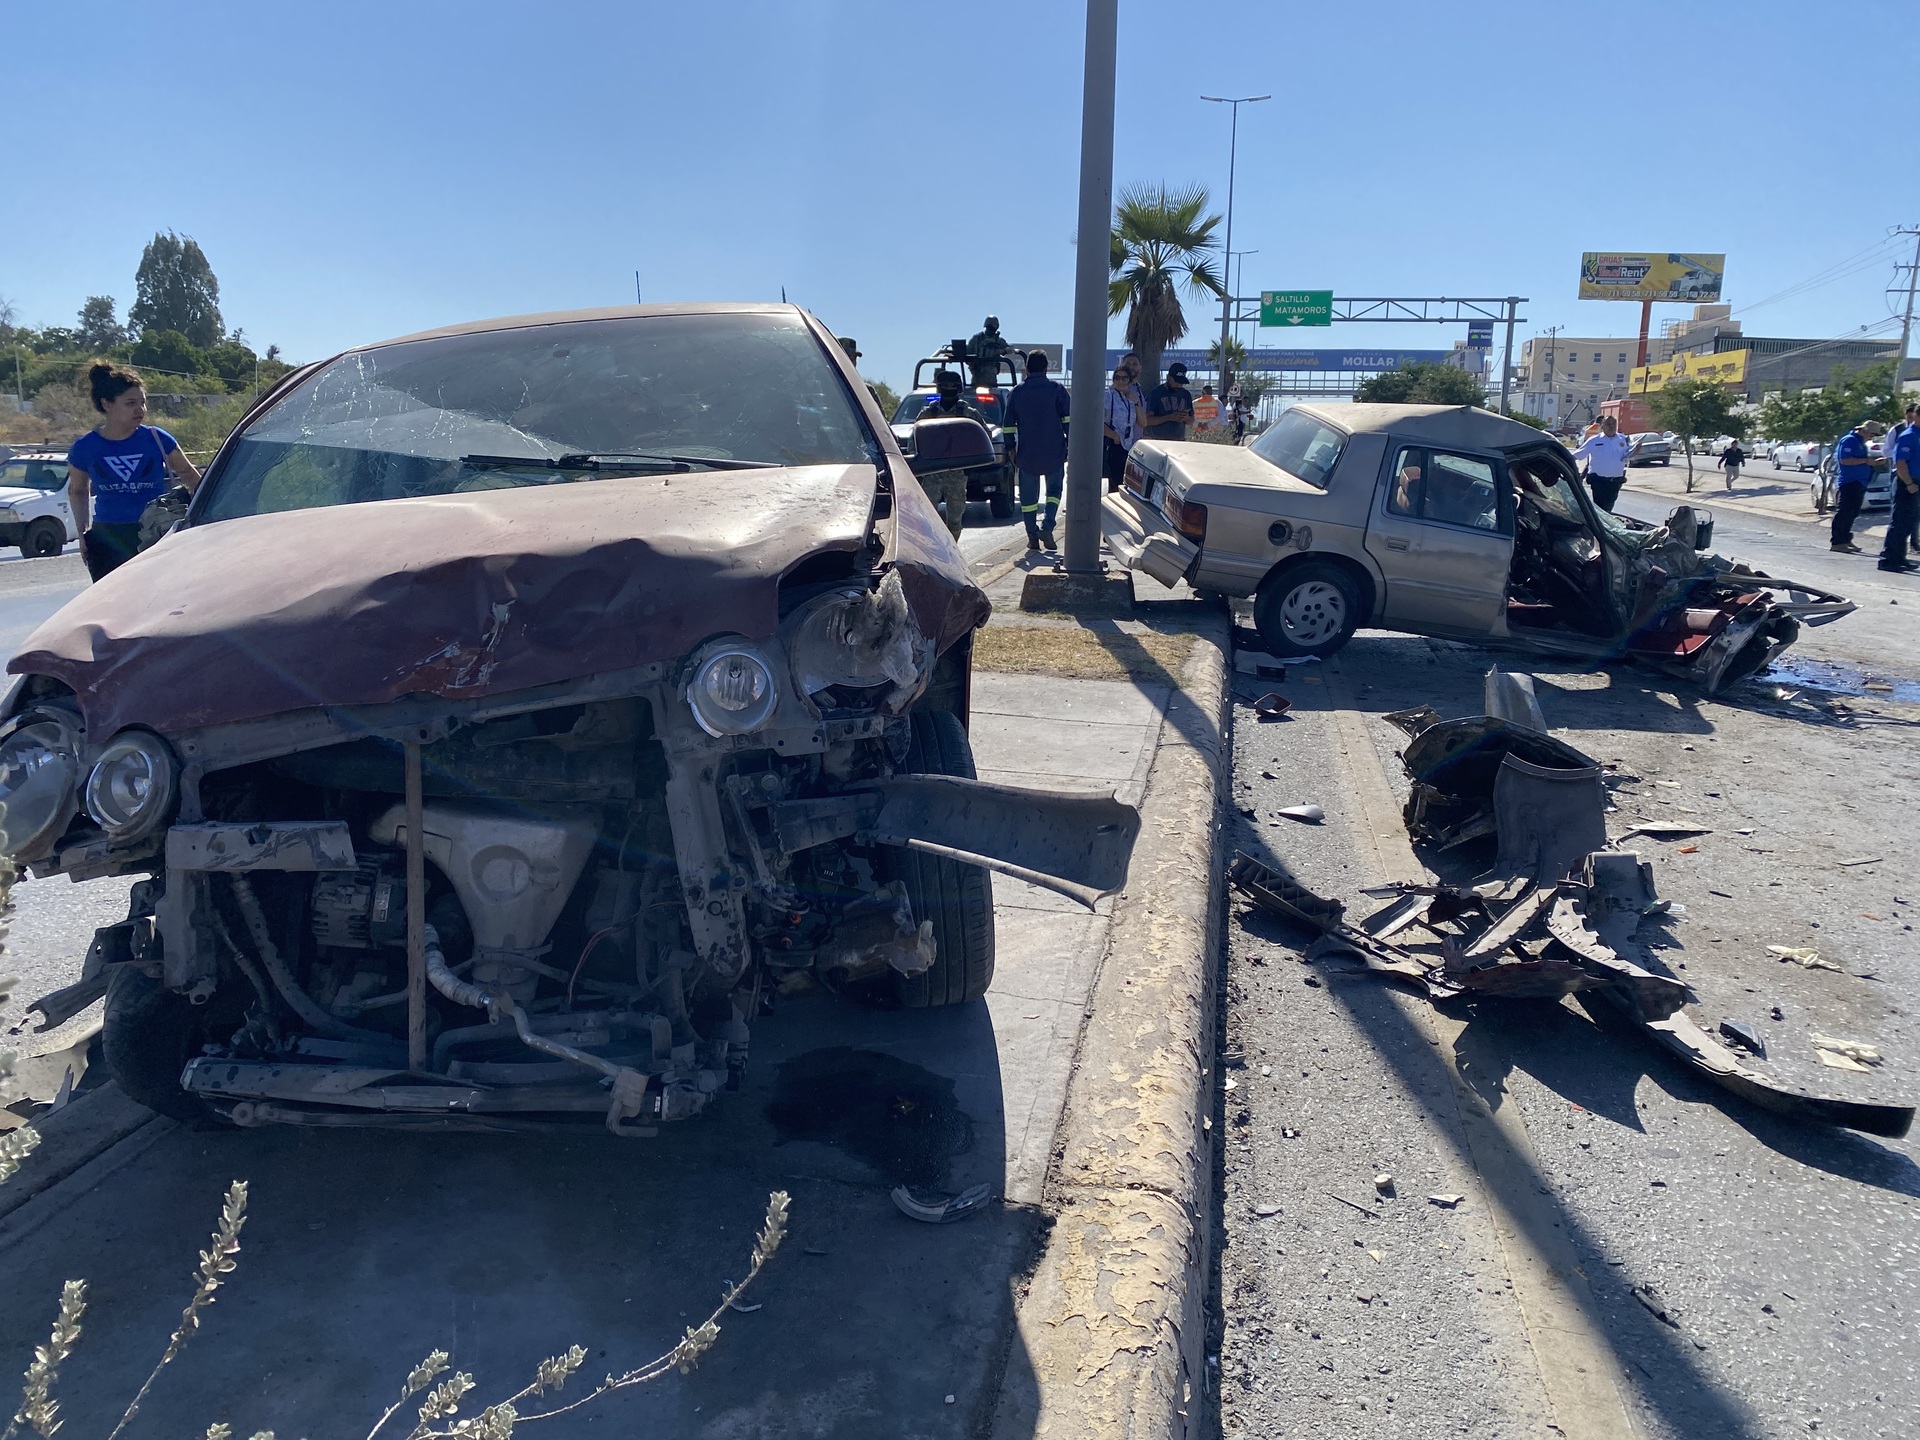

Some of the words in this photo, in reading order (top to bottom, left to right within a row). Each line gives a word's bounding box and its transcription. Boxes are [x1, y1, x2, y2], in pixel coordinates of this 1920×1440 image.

[1598, 256, 1622, 264] GRUAS
[1275, 295, 1310, 303] SALTILLO
[1274, 306, 1327, 314] MATAMOROS
[1246, 357, 1319, 368] generaciones
[1342, 357, 1394, 366] MOLLAR
